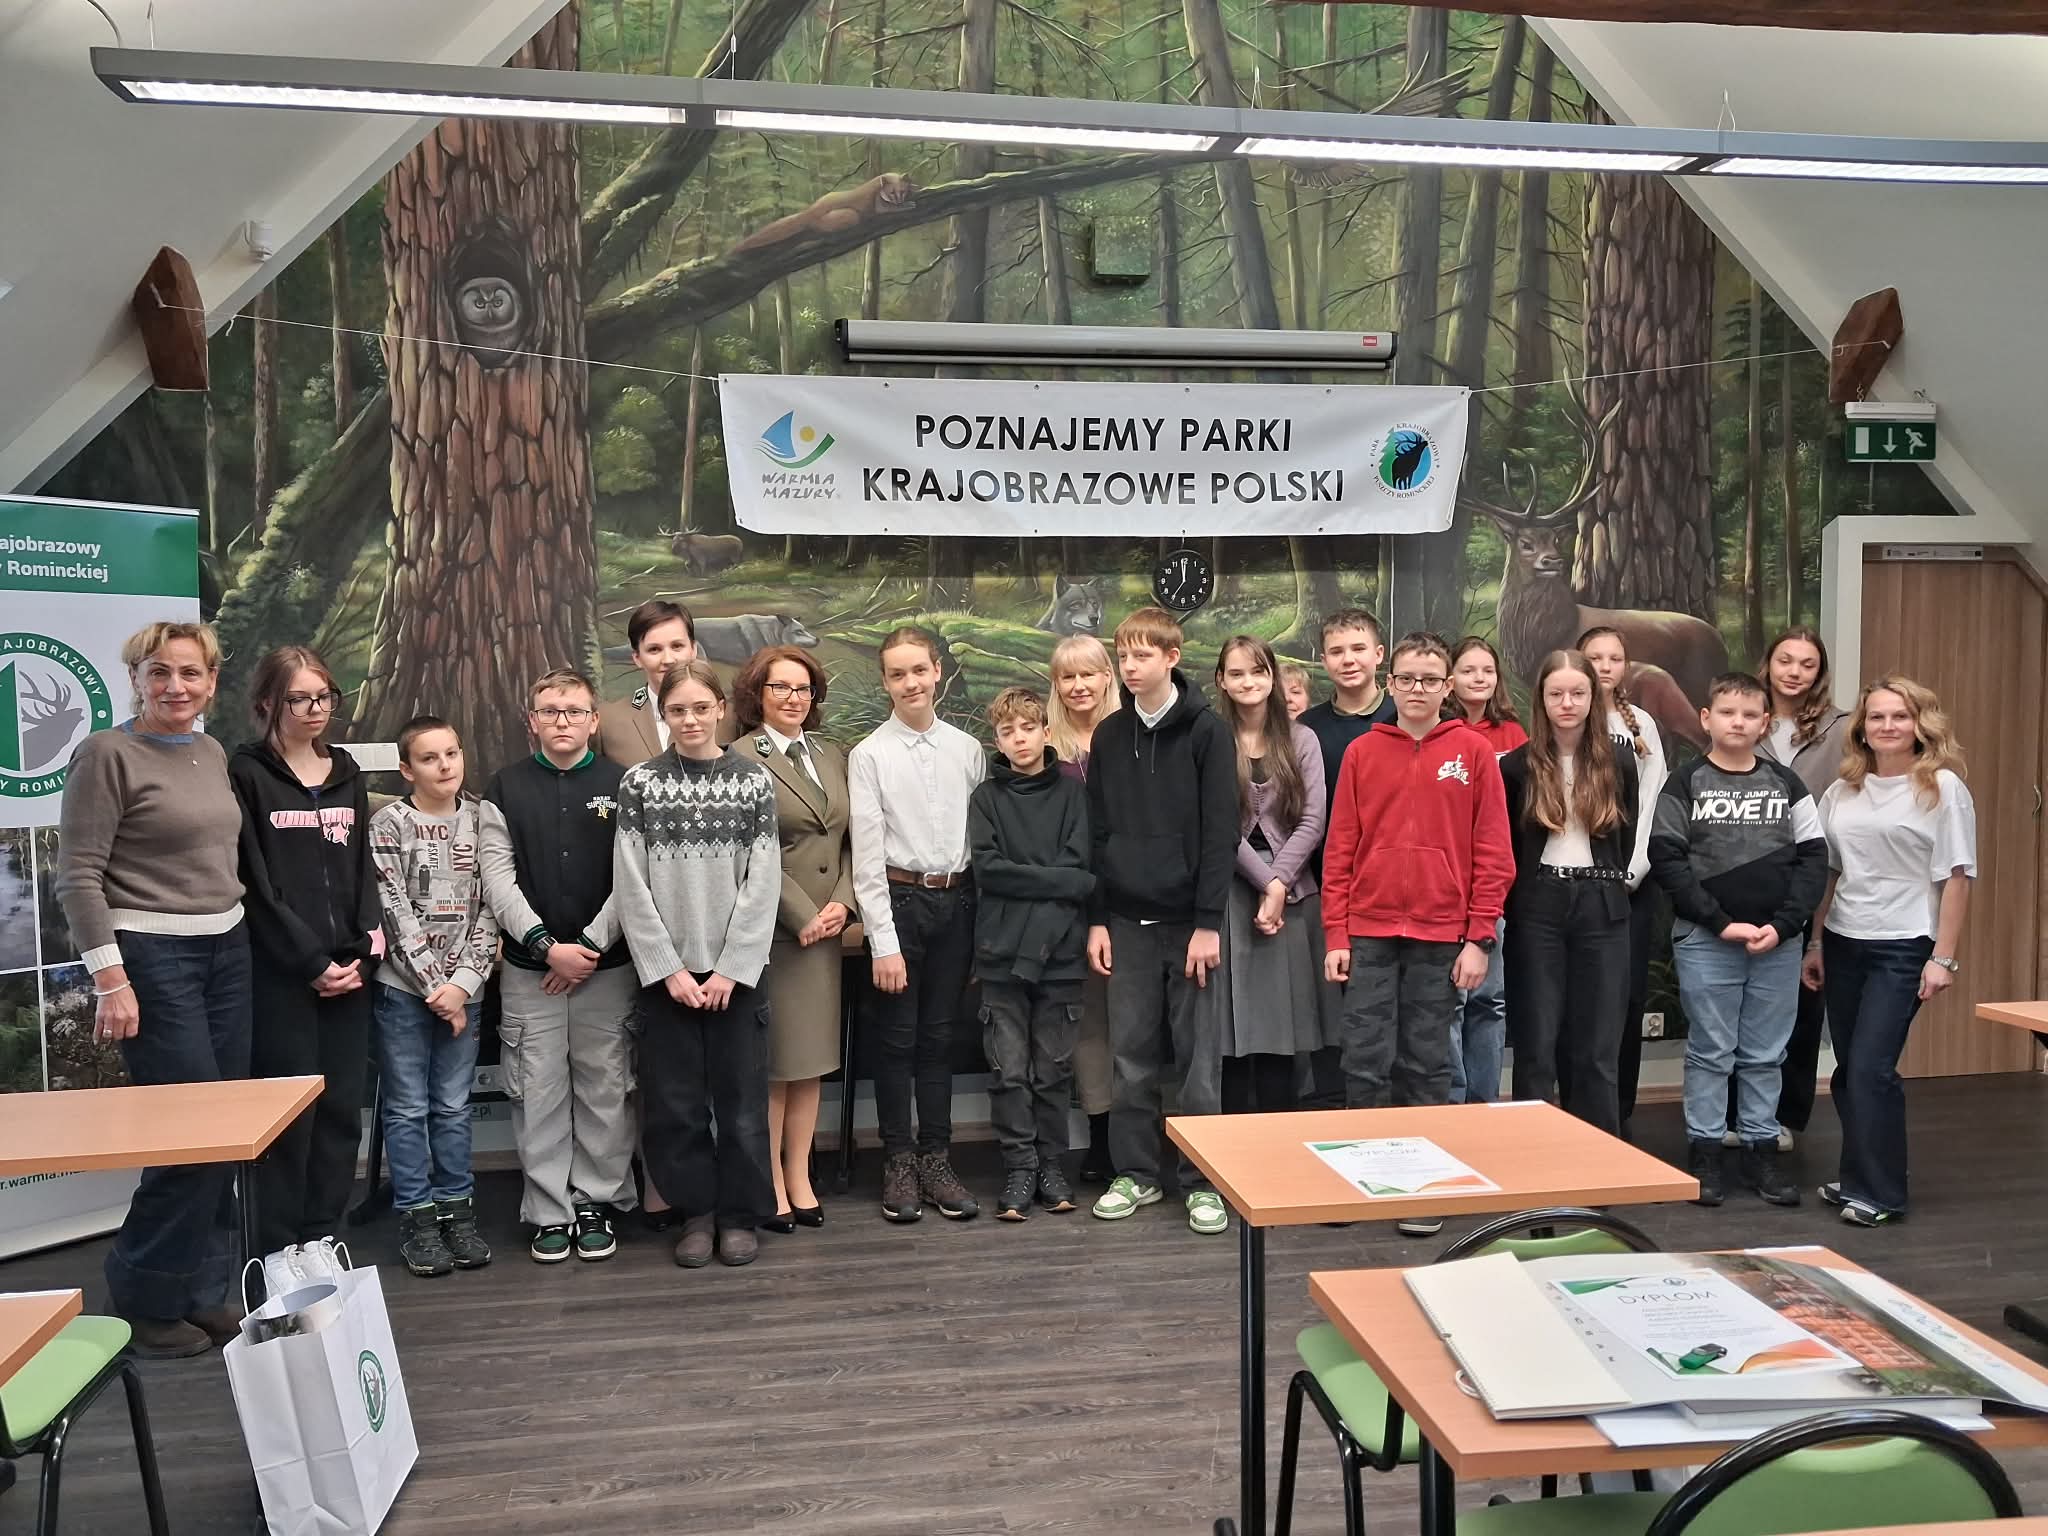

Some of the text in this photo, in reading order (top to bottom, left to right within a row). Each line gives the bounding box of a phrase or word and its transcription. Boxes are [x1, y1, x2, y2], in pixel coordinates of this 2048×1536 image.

[915, 414, 1291, 452] POZNAJEMY PARKI
[761, 471, 835, 485] WARMIA
[863, 467, 1343, 505] KRAJOBRAZOWE POLSKI
[7, 560, 109, 583] Rominckiej
[1700, 790, 1730, 798] REACH
[1691, 798, 1762, 820] MOVE
[1617, 1290, 1719, 1305] DYPLOM
